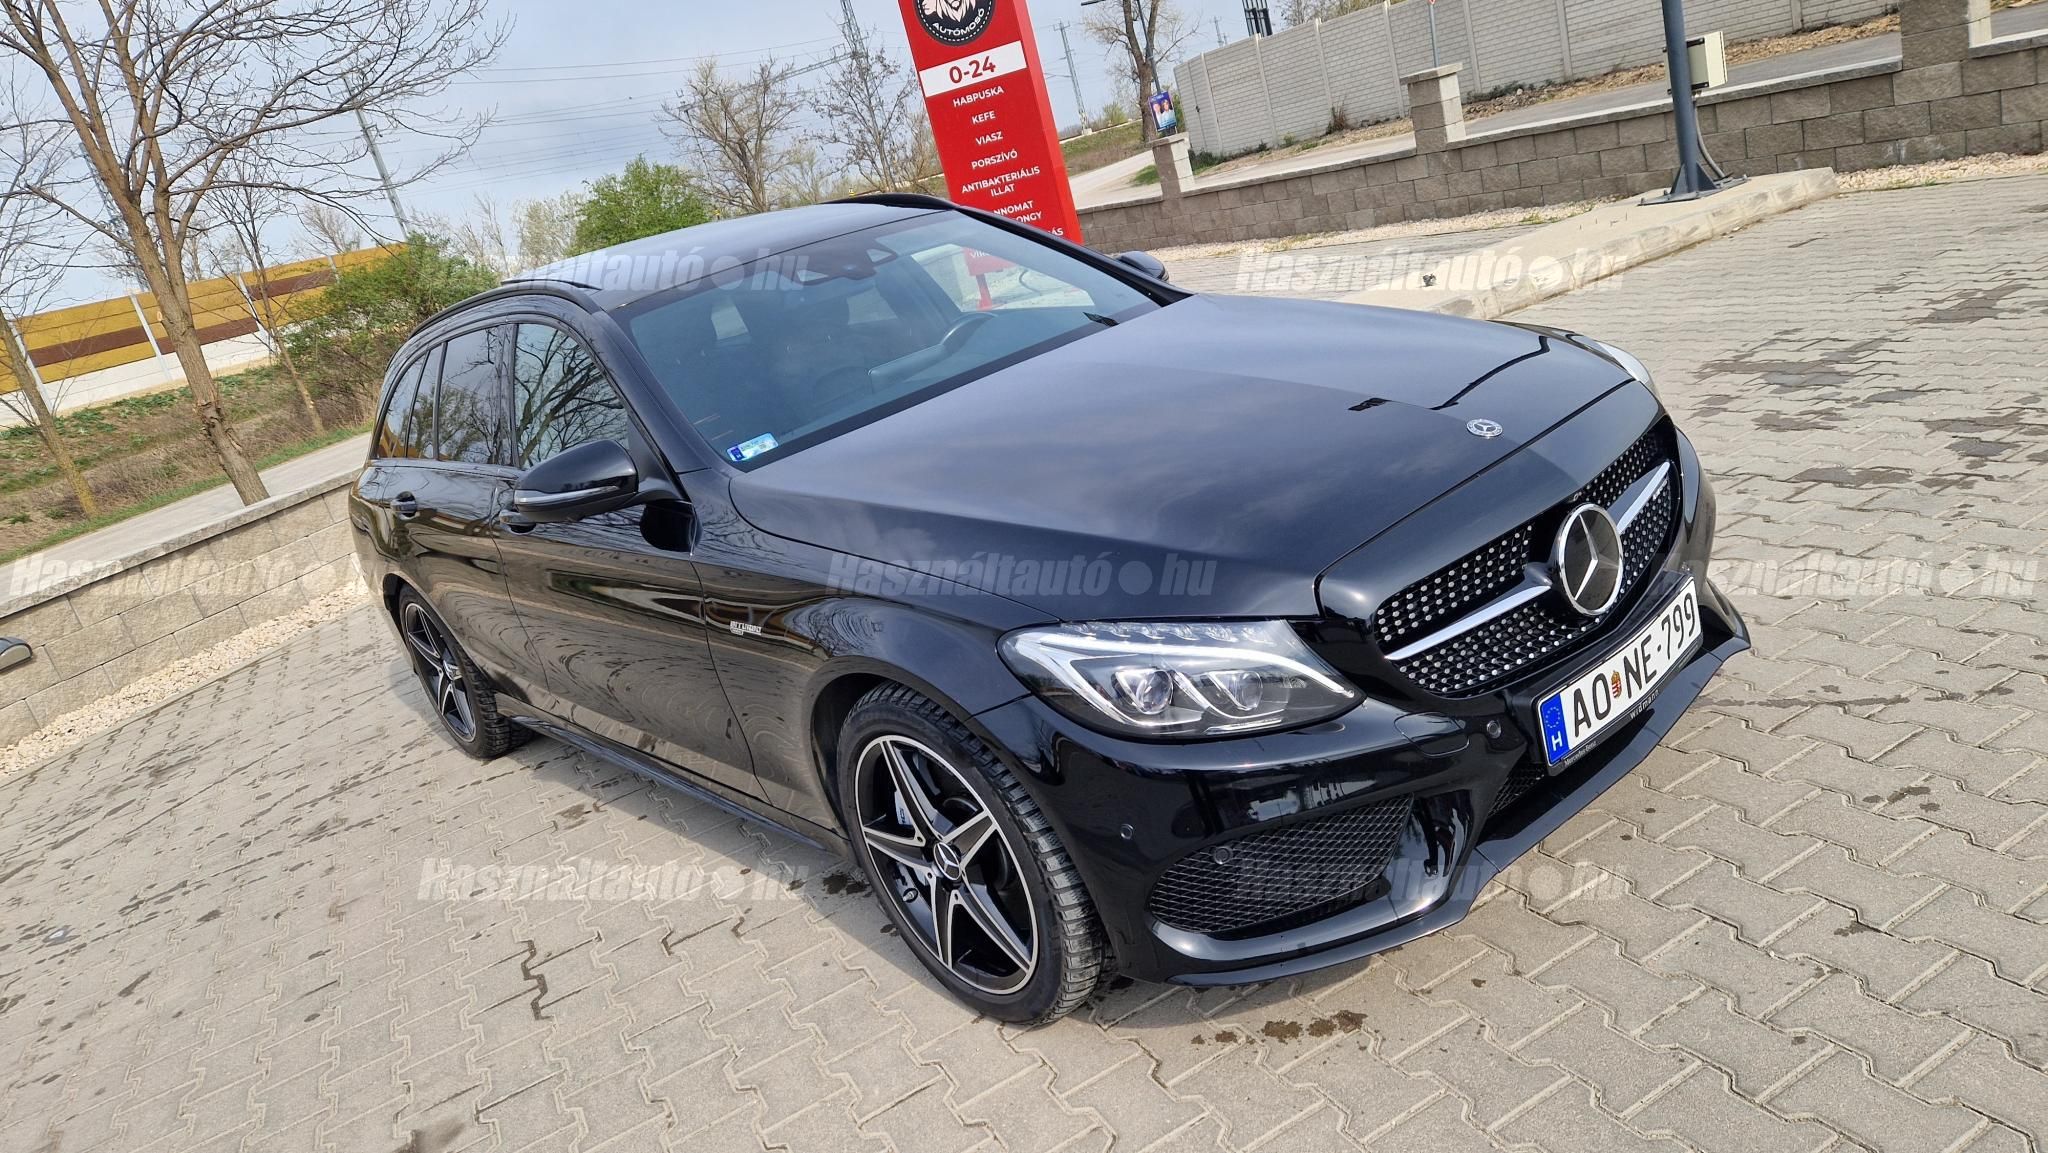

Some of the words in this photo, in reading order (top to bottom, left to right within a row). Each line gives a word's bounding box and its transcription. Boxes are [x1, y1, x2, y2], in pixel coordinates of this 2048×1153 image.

[932, 8, 985, 36] AUTÓMOSÓ
[949, 56, 996, 84] 0-24
[952, 85, 1004, 108] HABPUSKA
[971, 110, 996, 125] KEFE
[975, 131, 1004, 146] VIASZ
[971, 150, 1018, 170] PORSZÍVÓ
[961, 166, 1040, 194] ANTIBAKTERIÁLIS
[990, 184, 1016, 197] ILLAT
[1573, 673, 1613, 738] AO
[1623, 592, 1696, 699] NE-799
[1551, 731, 1563, 752] H
